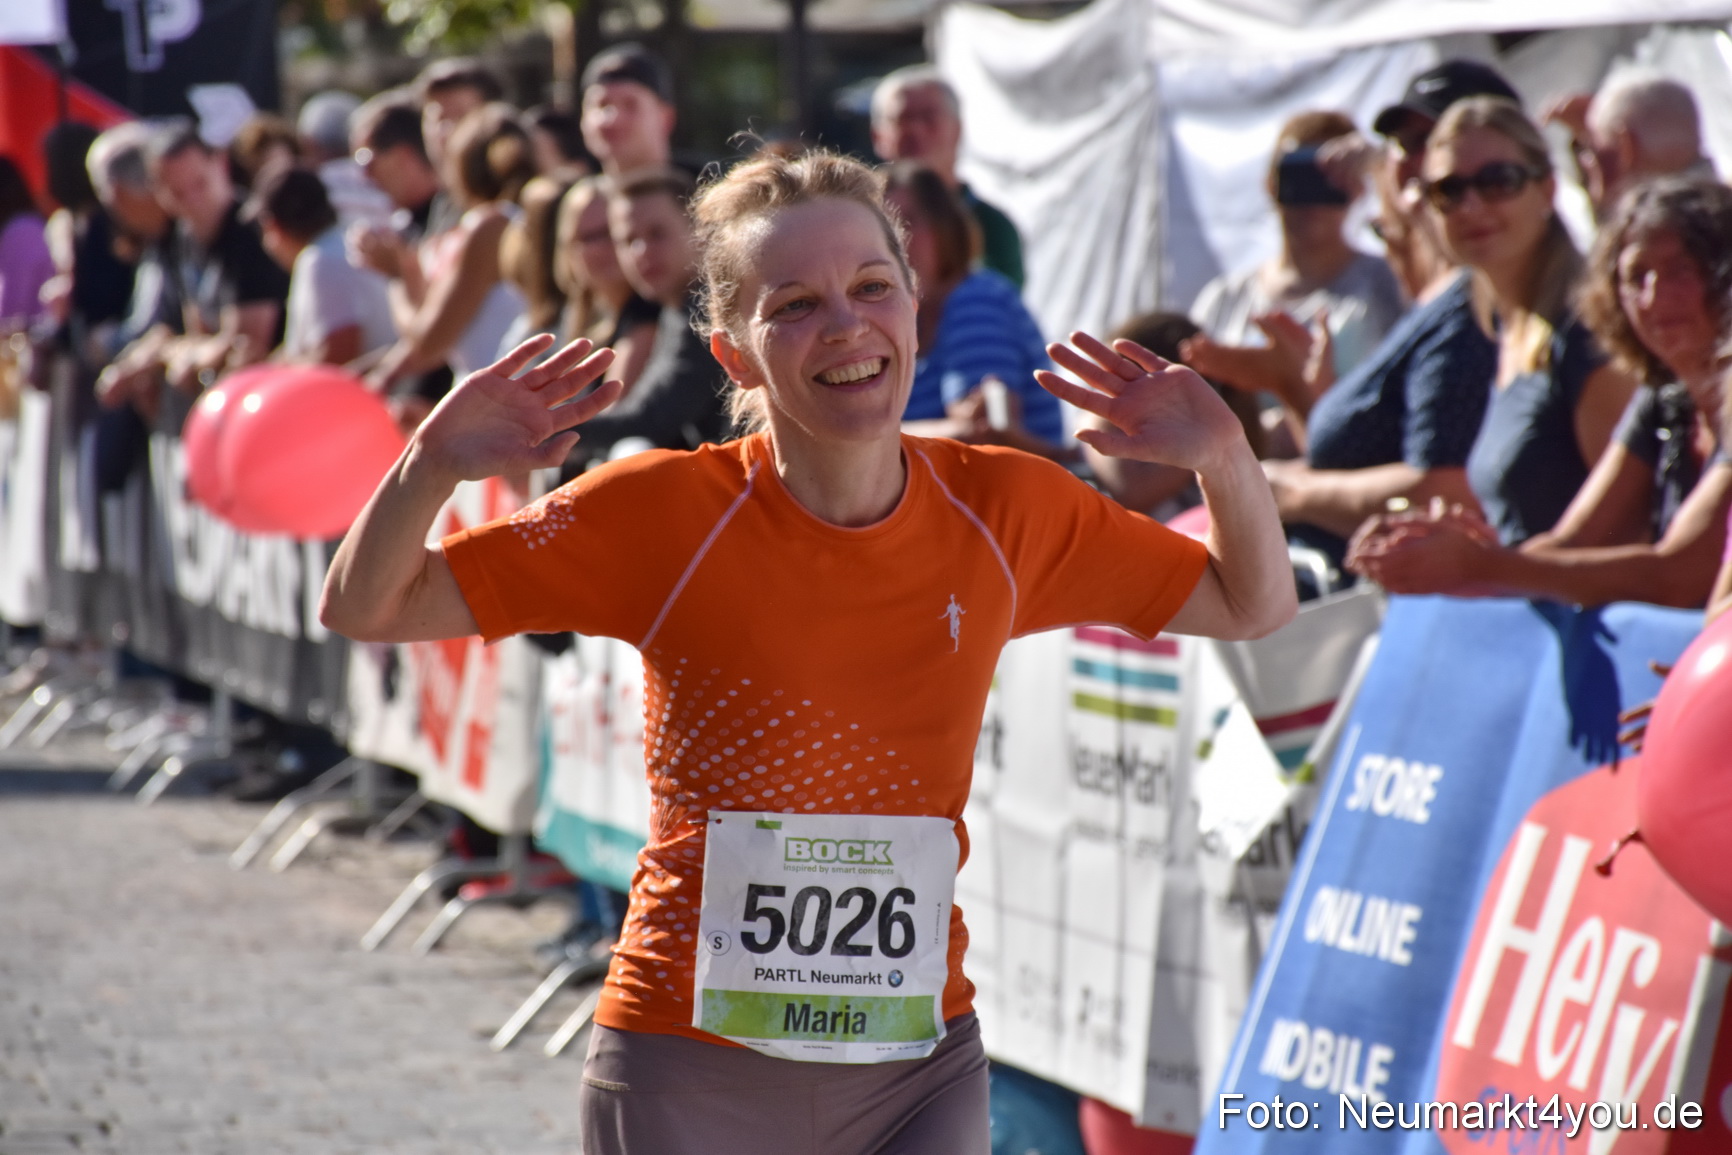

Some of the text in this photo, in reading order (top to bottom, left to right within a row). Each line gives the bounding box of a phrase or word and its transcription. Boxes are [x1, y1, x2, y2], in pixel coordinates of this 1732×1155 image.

[1346, 753, 1444, 824] STORE
[784, 837, 894, 865] BOCK
[783, 863, 894, 876] inspired by smart concepts
[740, 883, 916, 959] 5026
[1304, 886, 1422, 966] ONLINE
[713, 936, 723, 949] S
[754, 967, 882, 985] PARTL Neumarkt
[783, 1002, 867, 1035] Maria
[1259, 1018, 1394, 1106] MOBILE
